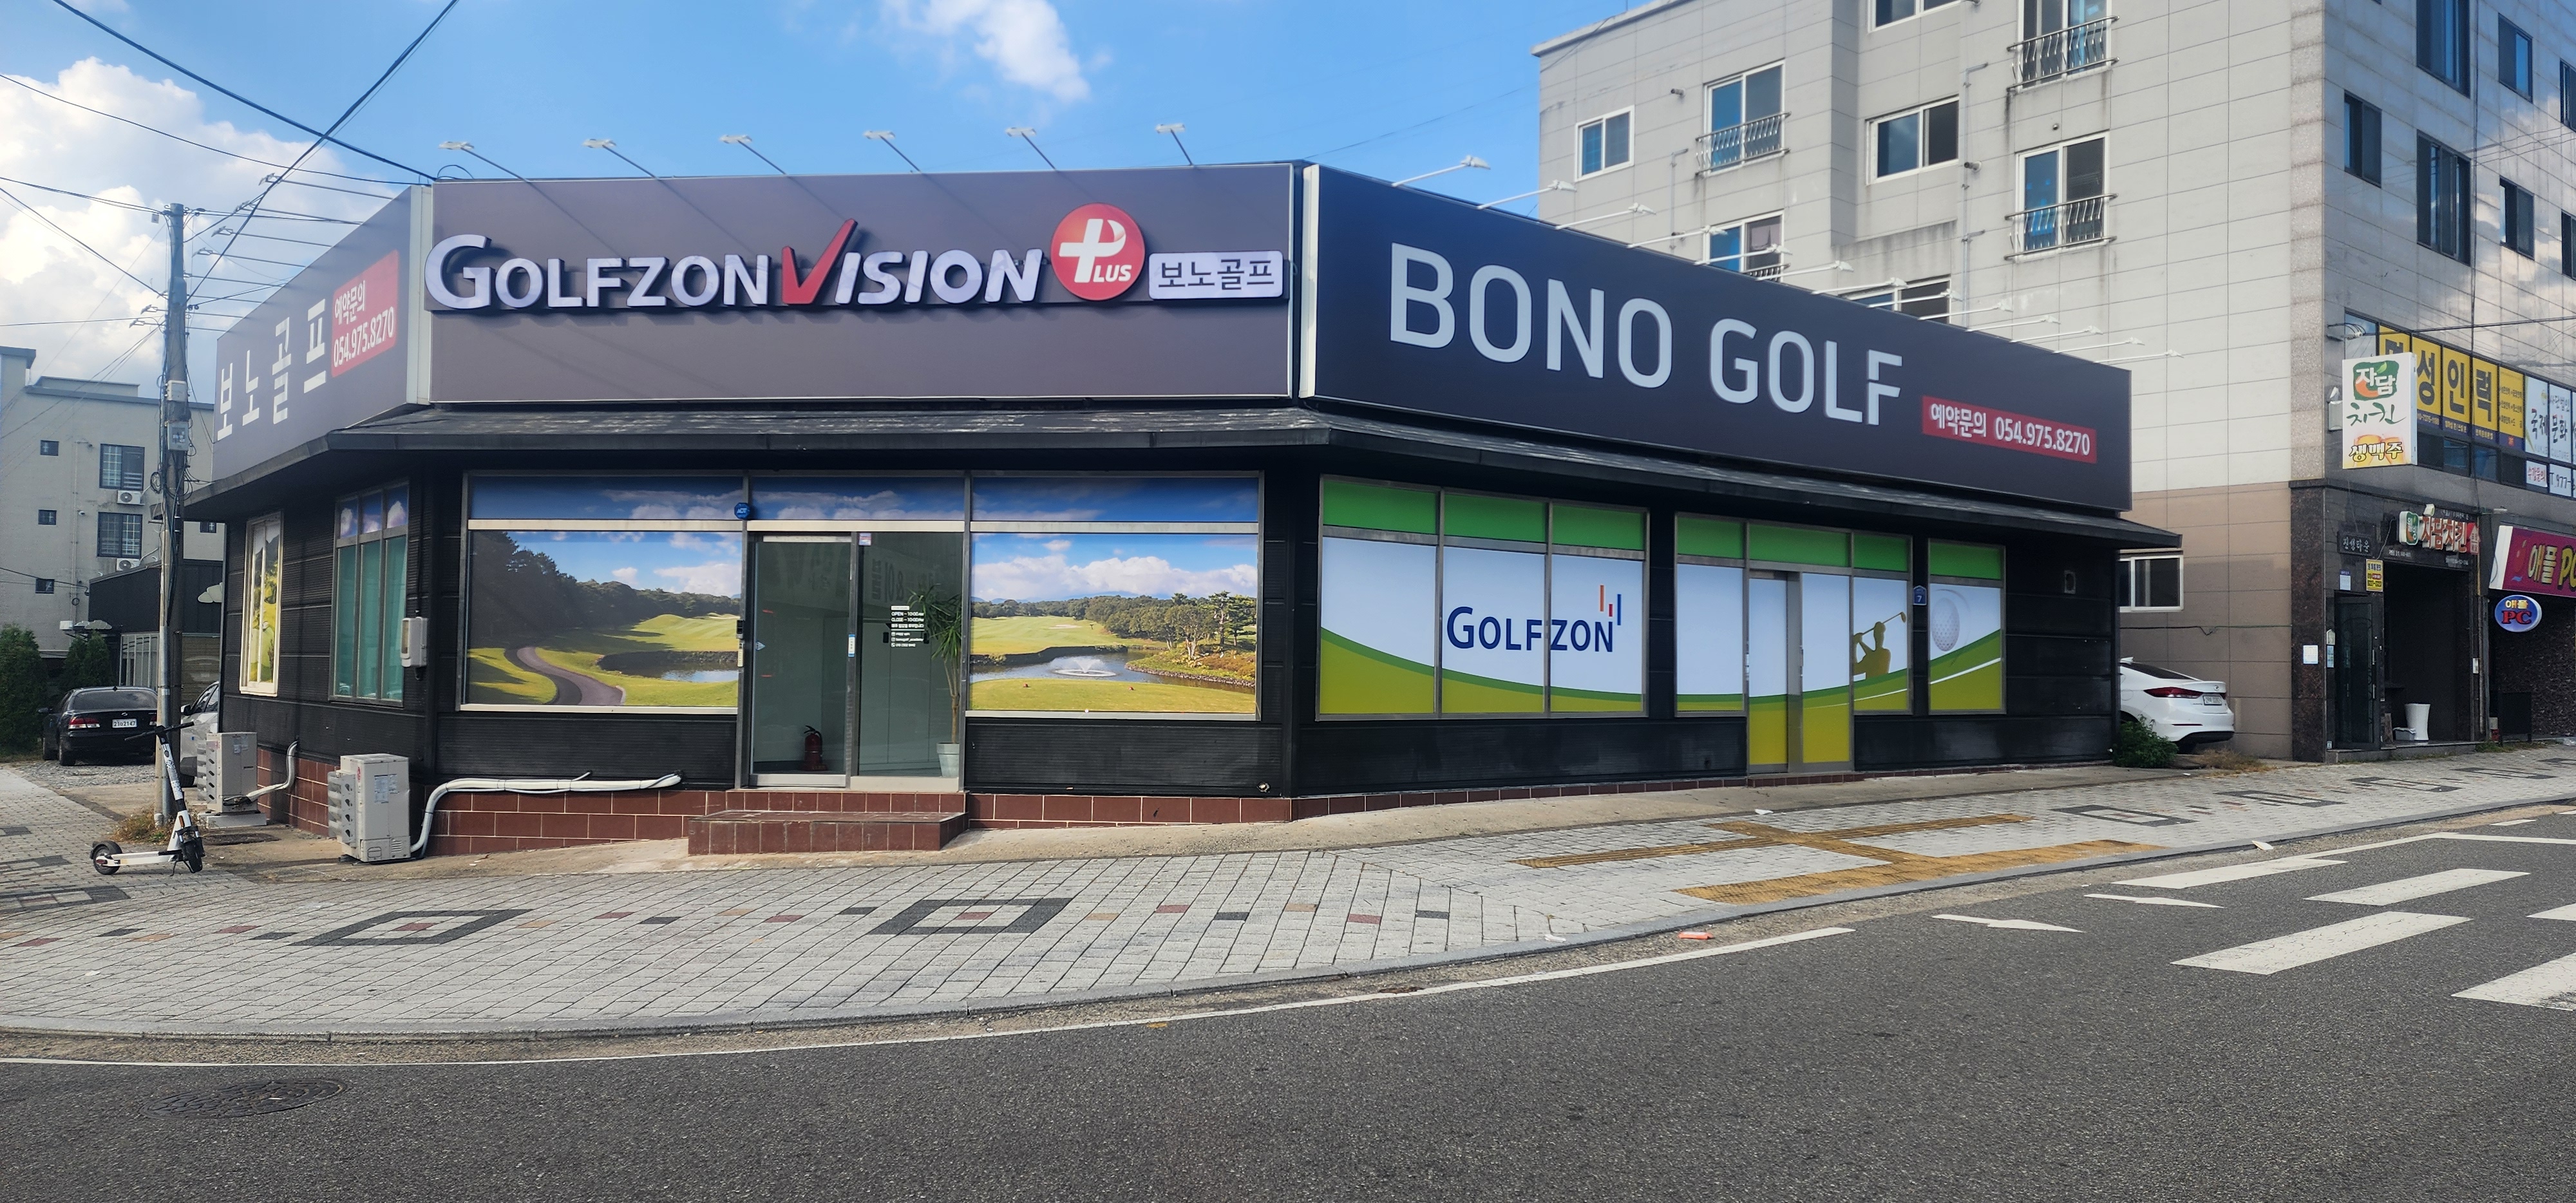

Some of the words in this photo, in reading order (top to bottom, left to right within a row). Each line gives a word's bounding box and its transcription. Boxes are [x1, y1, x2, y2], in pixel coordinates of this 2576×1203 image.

[424, 234, 768, 310] GOLFZON
[782, 218, 1044, 305] VISION
[1157, 258, 1274, 290] 보노골프
[334, 279, 366, 327] 예약문의
[333, 306, 394, 368] 054.975.8270
[1390, 242, 1672, 388] BONO
[1710, 318, 1902, 426] GOLF
[217, 298, 327, 441] 보노골프
[2356, 367, 2396, 395] 자담
[2385, 339, 2492, 422] 성인력
[1931, 404, 1986, 438] 예약문의
[1994, 416, 2090, 456] 054.975.8270
[2346, 402, 2407, 426] 치킨
[2349, 441, 2403, 462] 생맥주
[2418, 516, 2467, 553] 자담치킨
[2528, 544, 2557, 584] 애플
[2501, 611, 2532, 625] PC
[2505, 600, 2528, 609] 애플
[1446, 606, 1613, 652] GOLFZON
